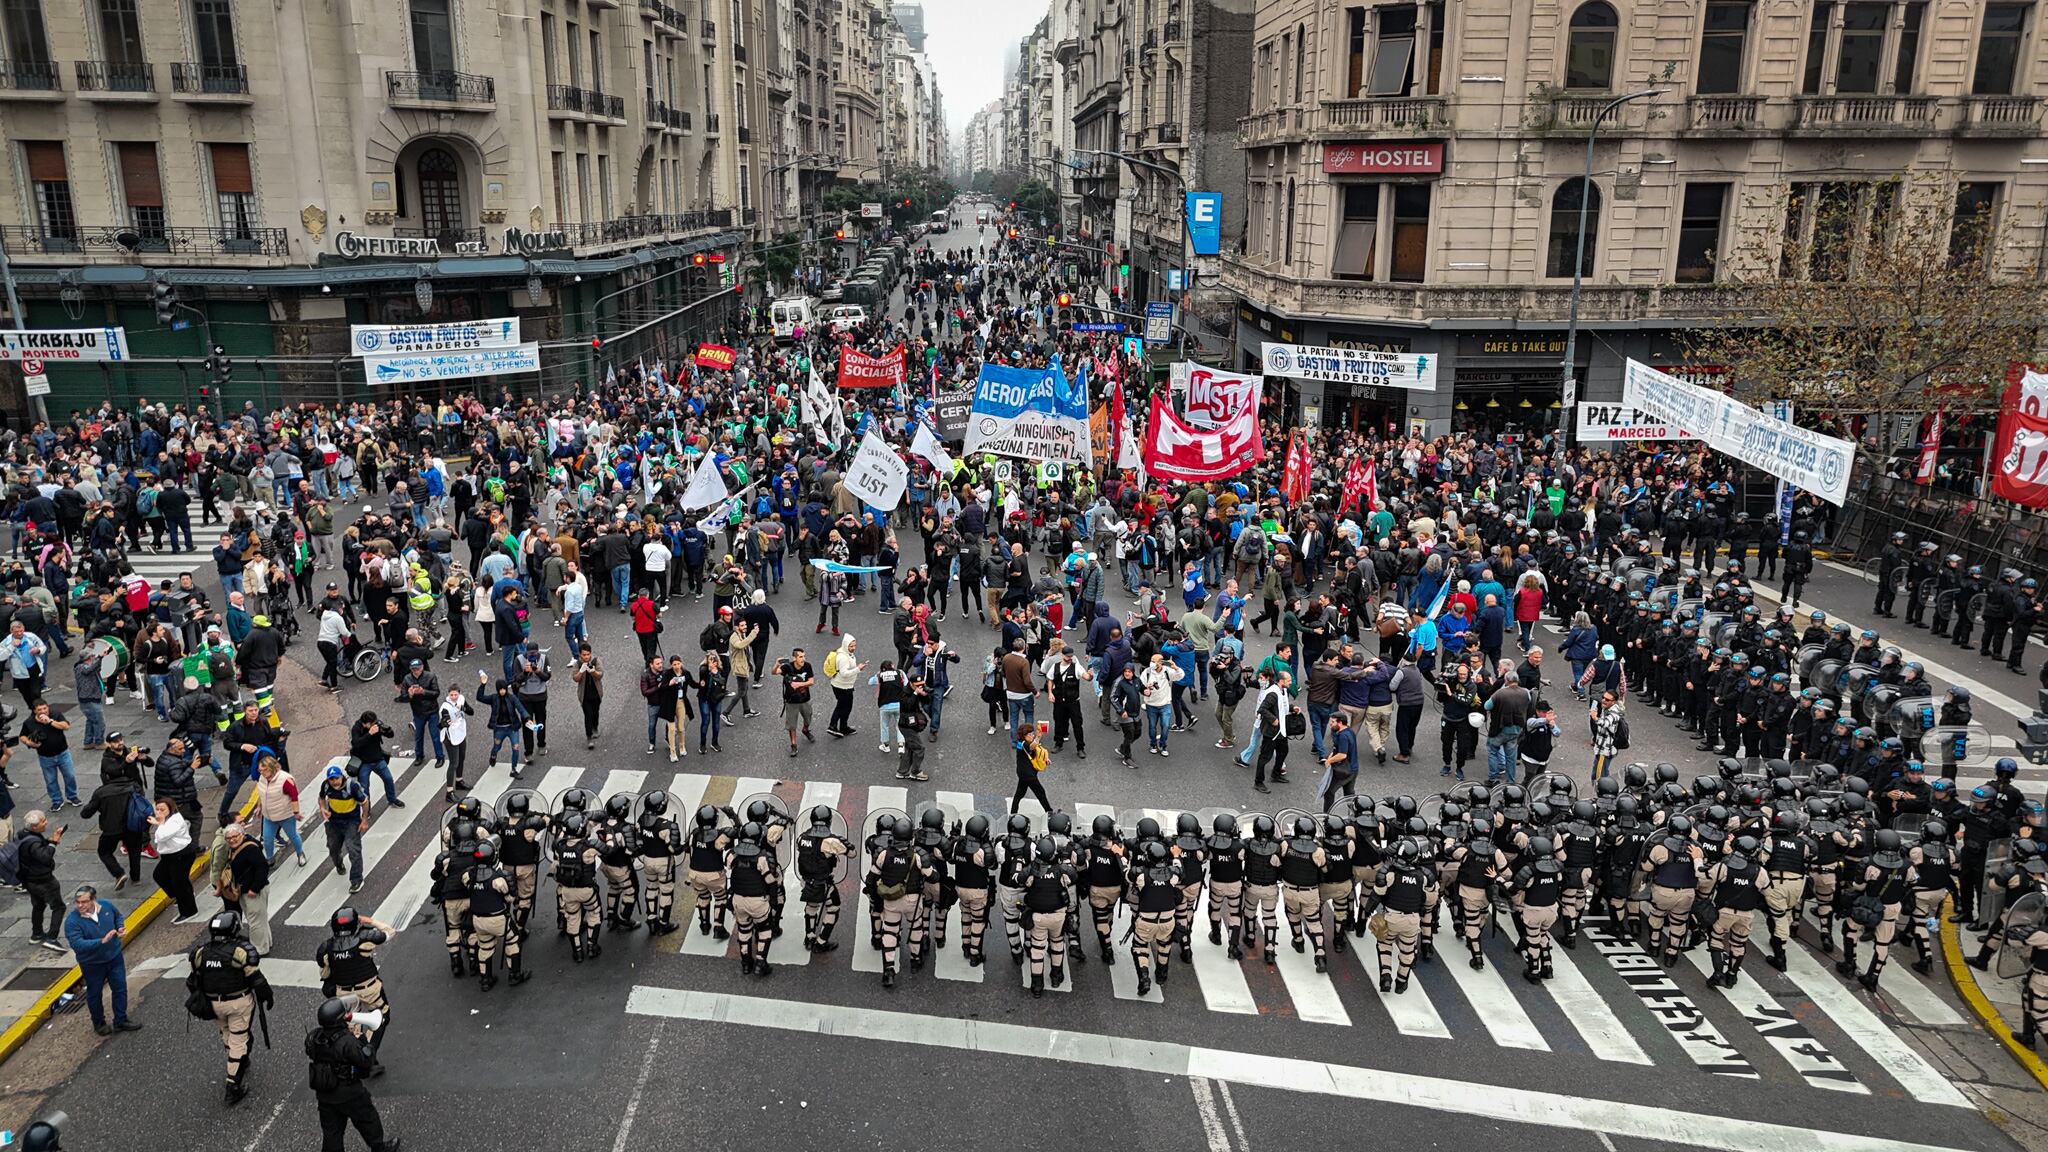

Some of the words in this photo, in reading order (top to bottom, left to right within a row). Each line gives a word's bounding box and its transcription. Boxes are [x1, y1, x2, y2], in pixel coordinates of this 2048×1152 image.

[1361, 150, 1433, 166] HOSTEL
[1195, 199, 1215, 222] E
[335, 230, 442, 259] CONFITERIA
[455, 241, 490, 255] DEL
[503, 226, 568, 257] MOLINO
[388, 329, 433, 345] GASTON
[436, 327, 478, 342] FRUTOS
[396, 340, 481, 352] PANADEROS
[1484, 341, 1509, 353] CAFE
[1511, 341, 1519, 352] &
[1522, 341, 1546, 352] TAKE
[1549, 340, 1568, 353] OUT
[22, 350, 81, 359] MONTERO
[698, 348, 732, 365] PRML
[1296, 346, 1307, 355] LA
[1343, 350, 1356, 359] NO
[1359, 351, 1370, 361] SE
[1373, 353, 1399, 362] VENDE
[402, 368, 416, 379] NO
[419, 367, 433, 378] SE
[474, 363, 485, 373] SE
[1297, 355, 1341, 373] GASTON
[1344, 359, 1388, 376] FRUTOS
[1303, 369, 1391, 385] PANADEROS
[1190, 373, 1242, 420] MST
[1607, 428, 1666, 438] MARCELO
[858, 472, 889, 497] UST
[1922, 707, 1934, 728] PFA
[1954, 737, 1967, 760] PFA
[643, 830, 654, 838] PNA
[697, 841, 707, 849] PNA
[801, 839, 813, 848] PNA
[1702, 842, 1717, 851] PNA
[1780, 840, 1796, 849] PNA
[894, 857, 906, 865] PNA
[1096, 856, 1111, 865] PNA
[1402, 875, 1417, 884] PNA
[1733, 877, 1749, 886] PNA
[206, 960, 222, 968] PNA
